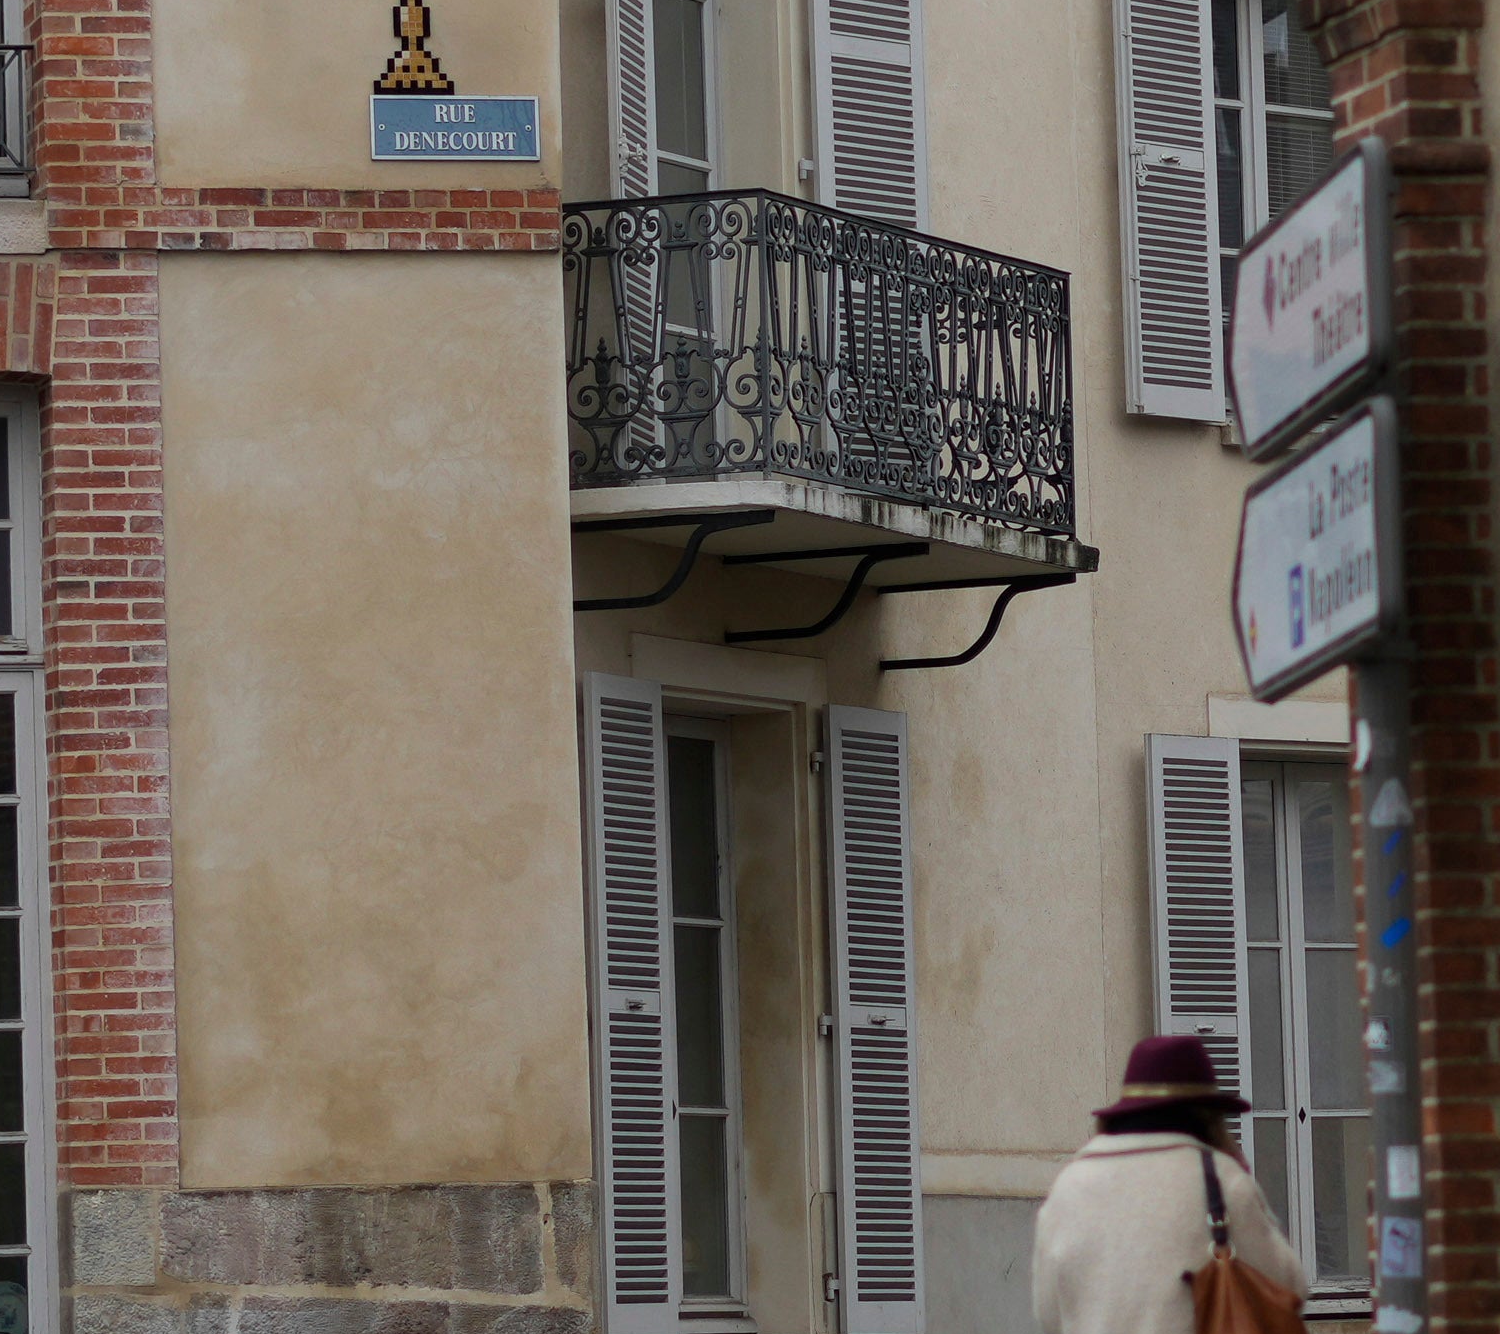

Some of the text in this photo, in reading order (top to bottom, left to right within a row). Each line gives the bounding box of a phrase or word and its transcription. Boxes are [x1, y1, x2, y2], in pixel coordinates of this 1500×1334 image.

[434, 104, 476, 123] RUE
[393, 131, 517, 152] DENECOURT
[1278, 238, 1322, 310] Centre
[1308, 457, 1369, 540] La Poste
